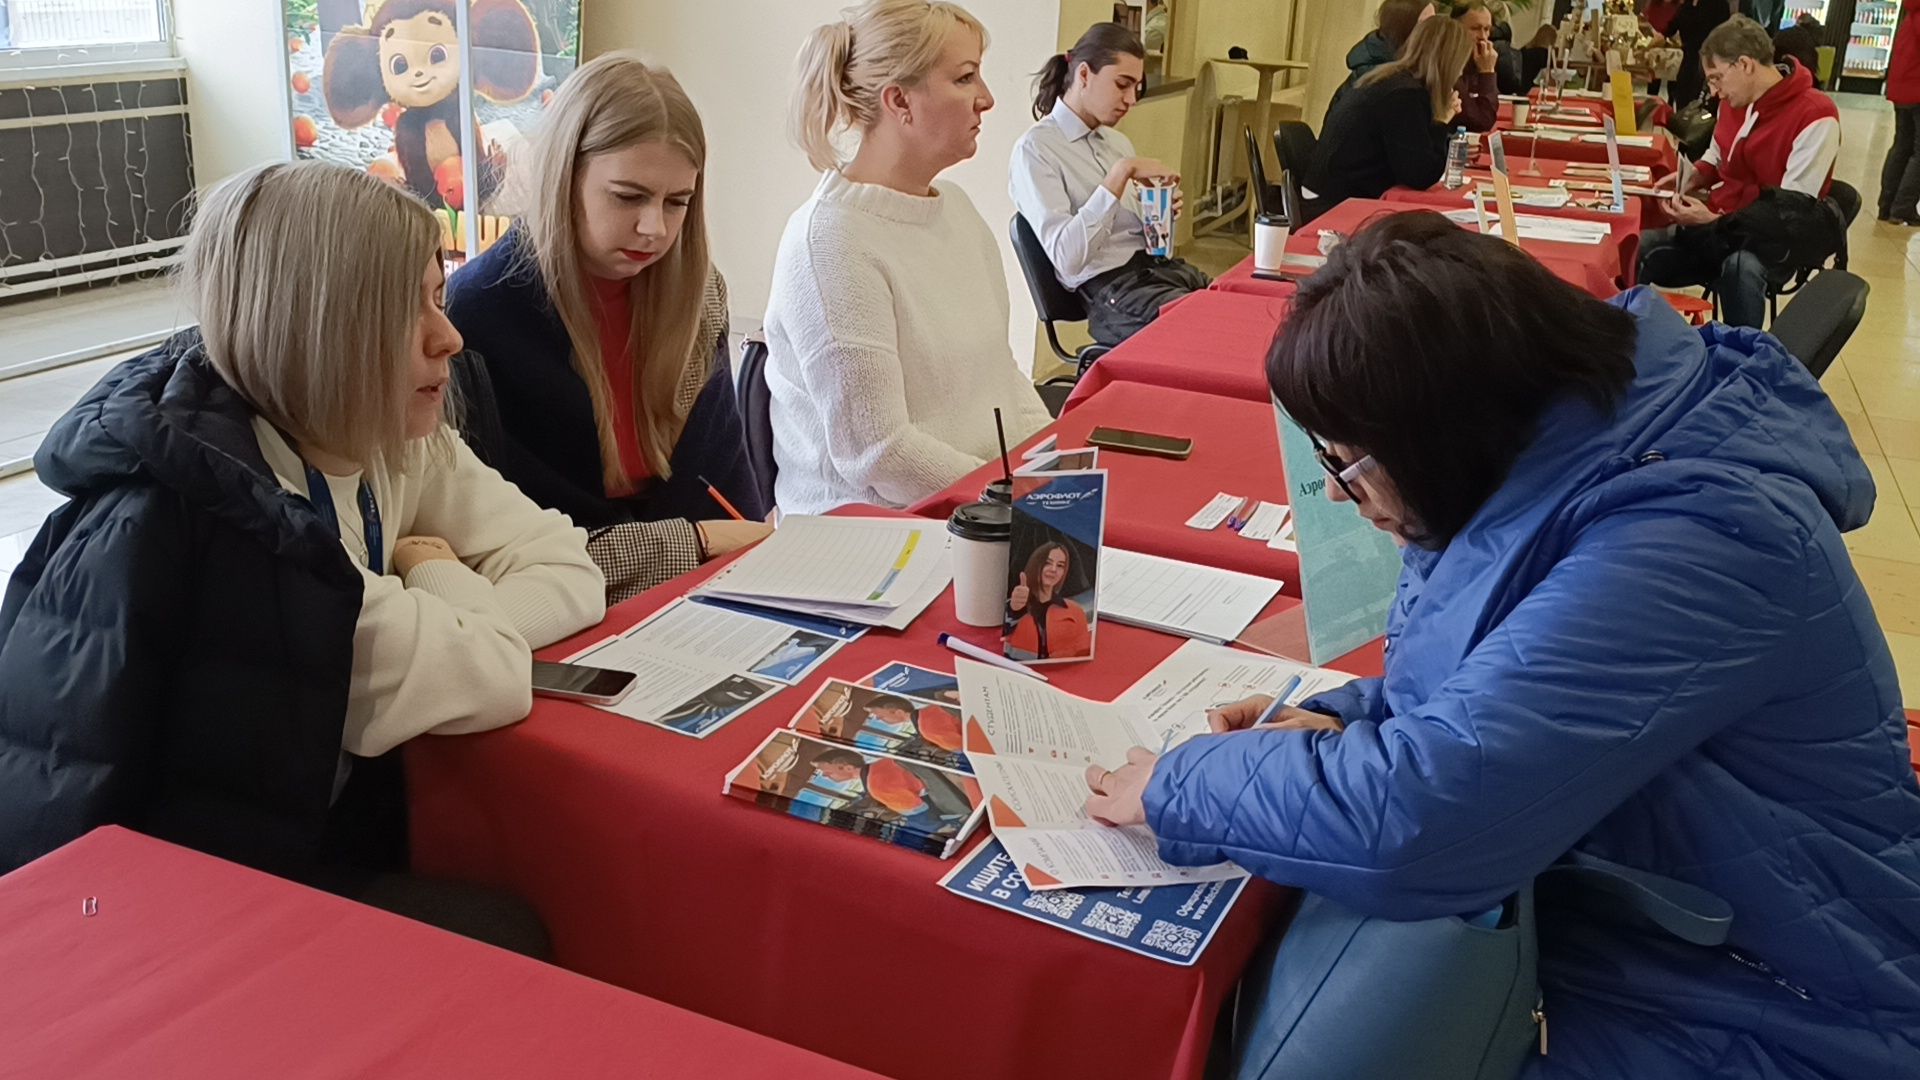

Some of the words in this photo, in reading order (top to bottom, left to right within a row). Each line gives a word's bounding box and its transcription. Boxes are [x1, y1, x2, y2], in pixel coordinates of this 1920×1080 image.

[966, 852, 1011, 892] ИЩИТЕ
[991, 882, 1011, 900] В
[1002, 869, 1023, 888] СО
